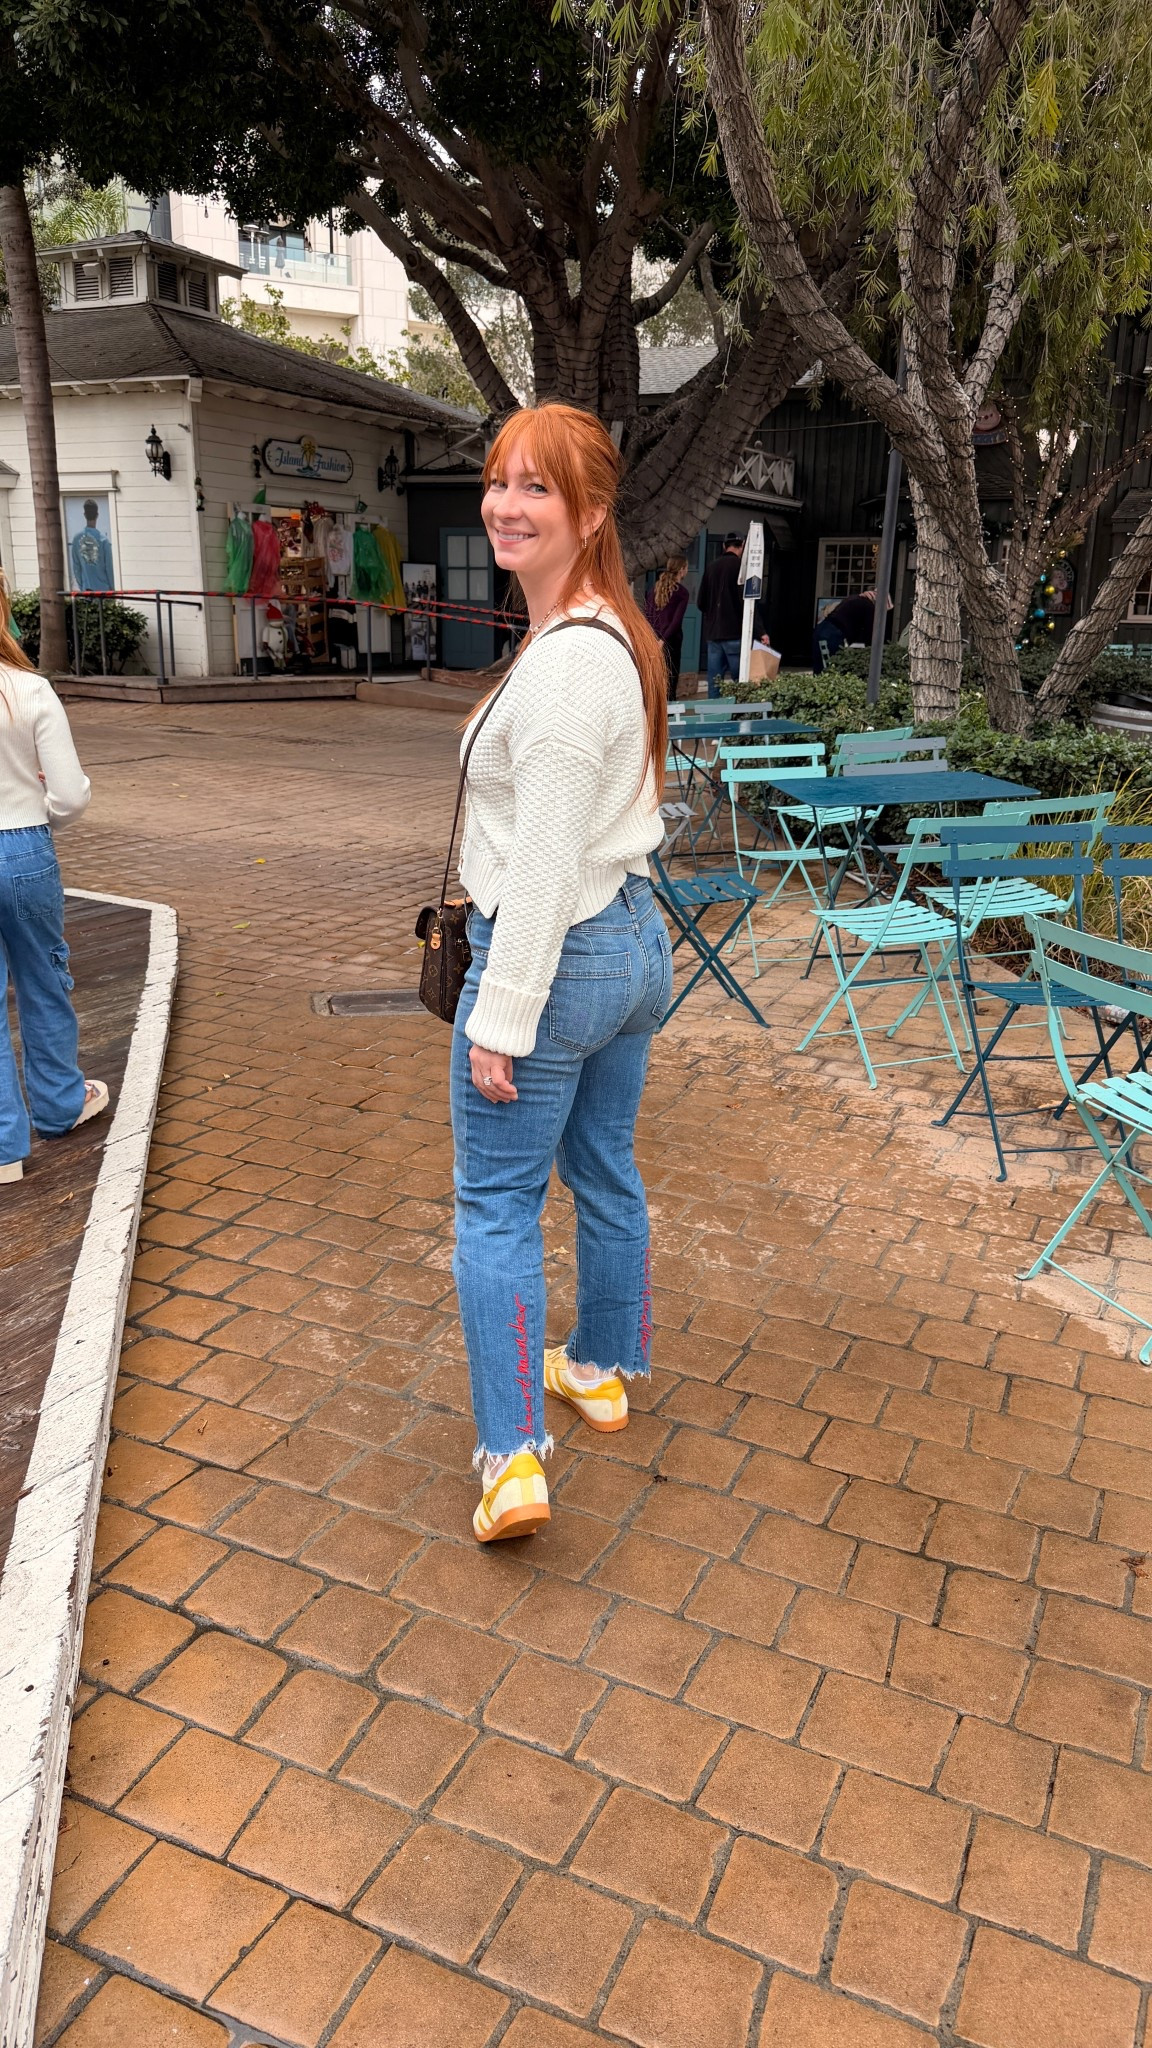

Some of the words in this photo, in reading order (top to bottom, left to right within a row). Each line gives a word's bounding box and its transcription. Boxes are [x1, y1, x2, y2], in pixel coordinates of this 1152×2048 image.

[275, 447, 304, 467] Island
[313, 453, 346, 472] Fashion
[508, 1293, 531, 1376] mender
[515, 1378, 534, 1435] heart
